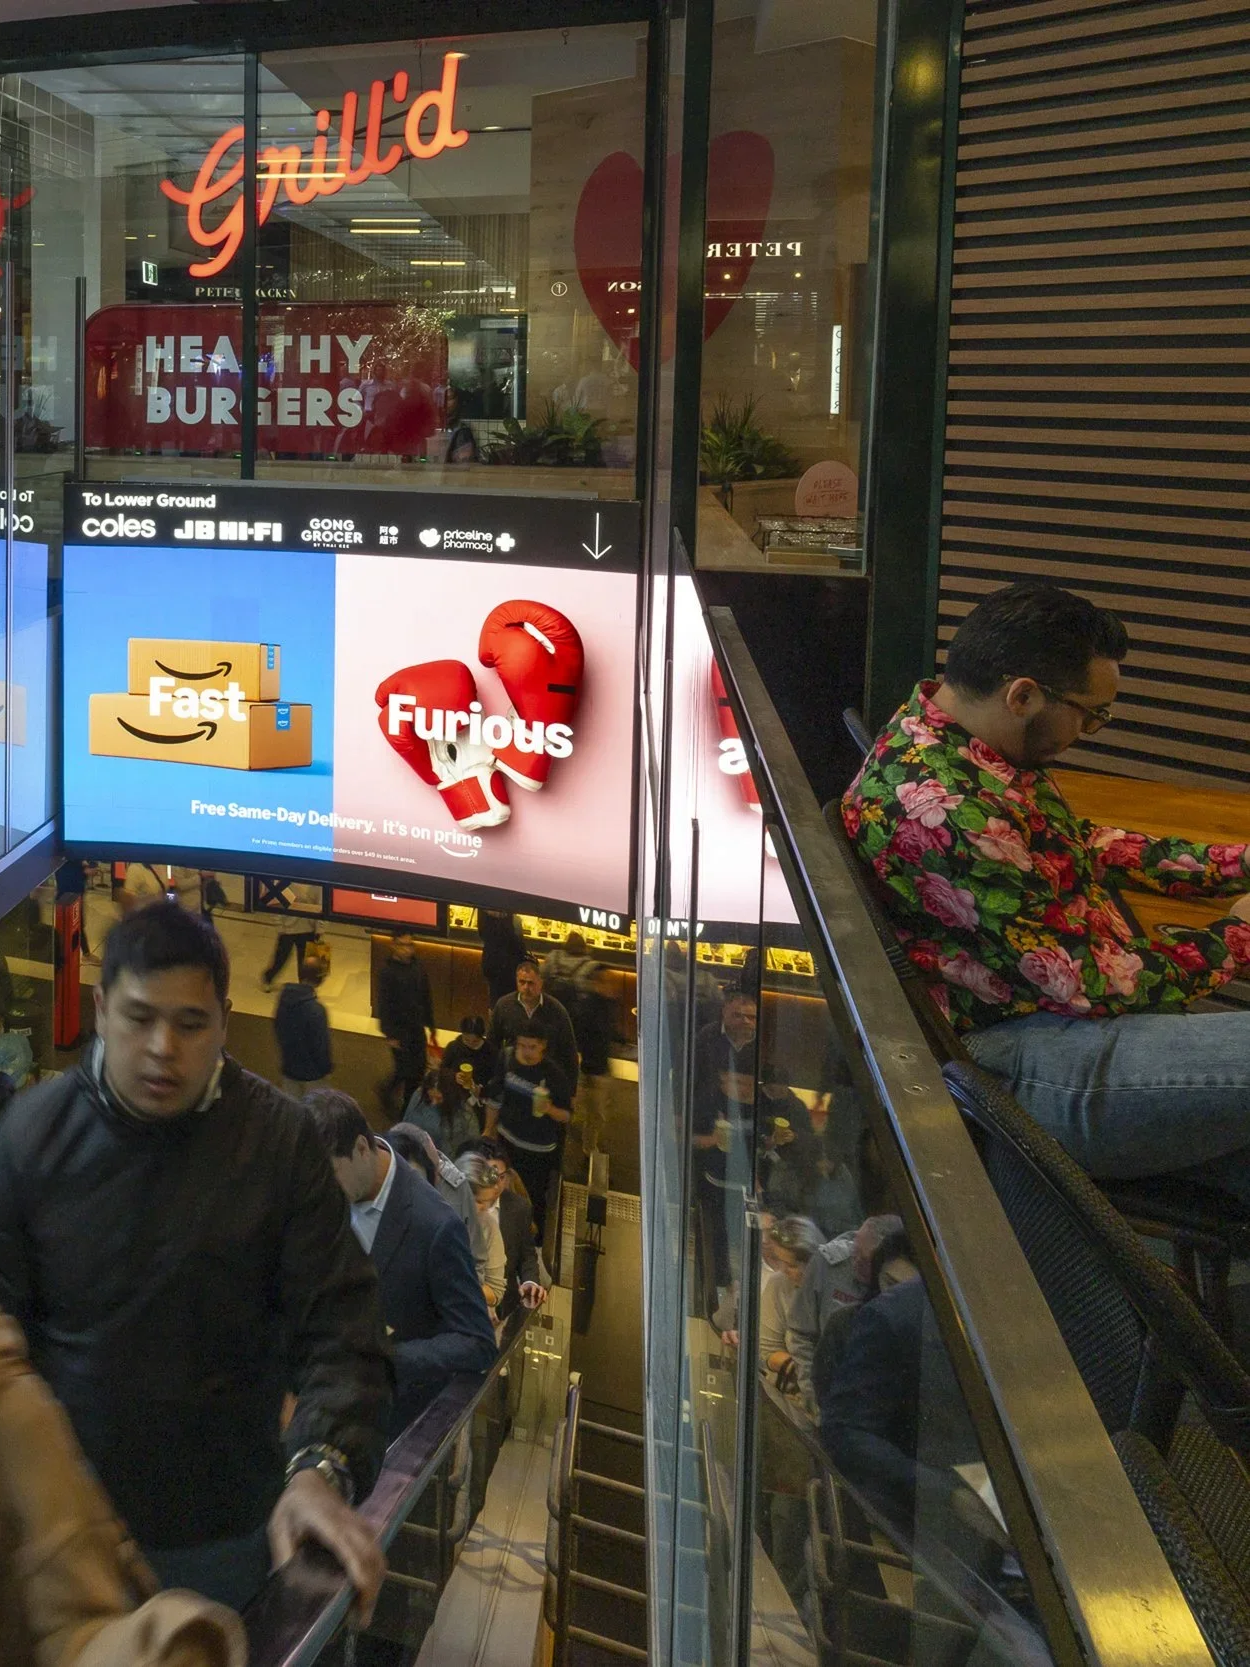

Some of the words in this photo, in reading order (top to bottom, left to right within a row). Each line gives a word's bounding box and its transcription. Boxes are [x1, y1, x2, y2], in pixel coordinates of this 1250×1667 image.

[160, 51, 469, 279] Grill'd
[146, 335, 373, 373] HEATHY
[82, 492, 102, 506] To
[105, 493, 154, 507] Lower
[156, 494, 216, 508] Ground
[82, 513, 157, 538] coles
[174, 519, 216, 540] JB
[218, 521, 283, 542] HI-FI
[300, 529, 363, 543] GROCER
[309, 517, 355, 531] GONG
[443, 529, 493, 542] priceline
[443, 540, 493, 552] pharmacy
[149, 676, 247, 722] Fast
[388, 693, 574, 758] Furious
[191, 800, 226, 816] Free
[228, 803, 305, 827] Same-Day
[308, 810, 377, 835] Delivery.
[383, 819, 408, 837] It's
[411, 826, 431, 840] on
[434, 828, 483, 849] prime
[579, 907, 620, 930] VMO
